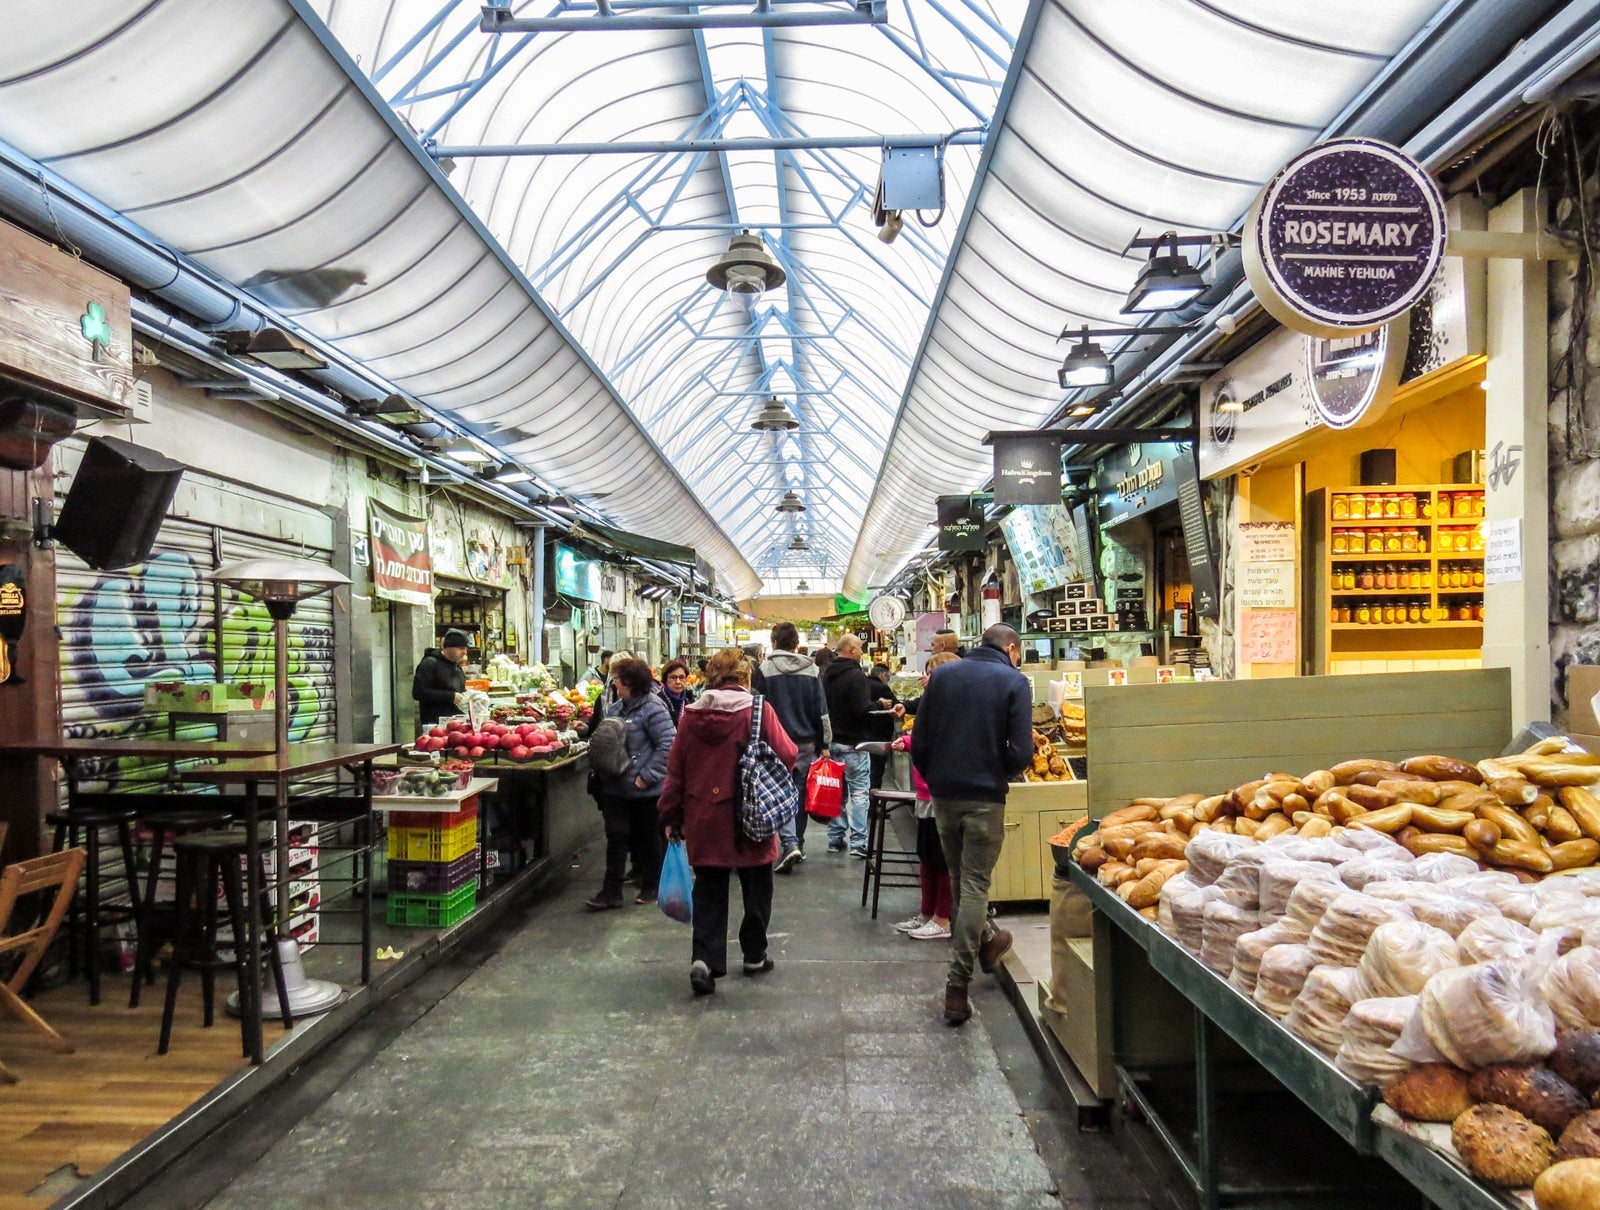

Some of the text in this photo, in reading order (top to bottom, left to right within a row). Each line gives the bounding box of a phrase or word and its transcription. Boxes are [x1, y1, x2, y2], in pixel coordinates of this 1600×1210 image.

[1306, 189, 1331, 200] Since
[1335, 188, 1366, 201] 1953
[1284, 220, 1419, 247] ROSEMARY
[1303, 266, 1396, 280] MAHNE YEHUDA
